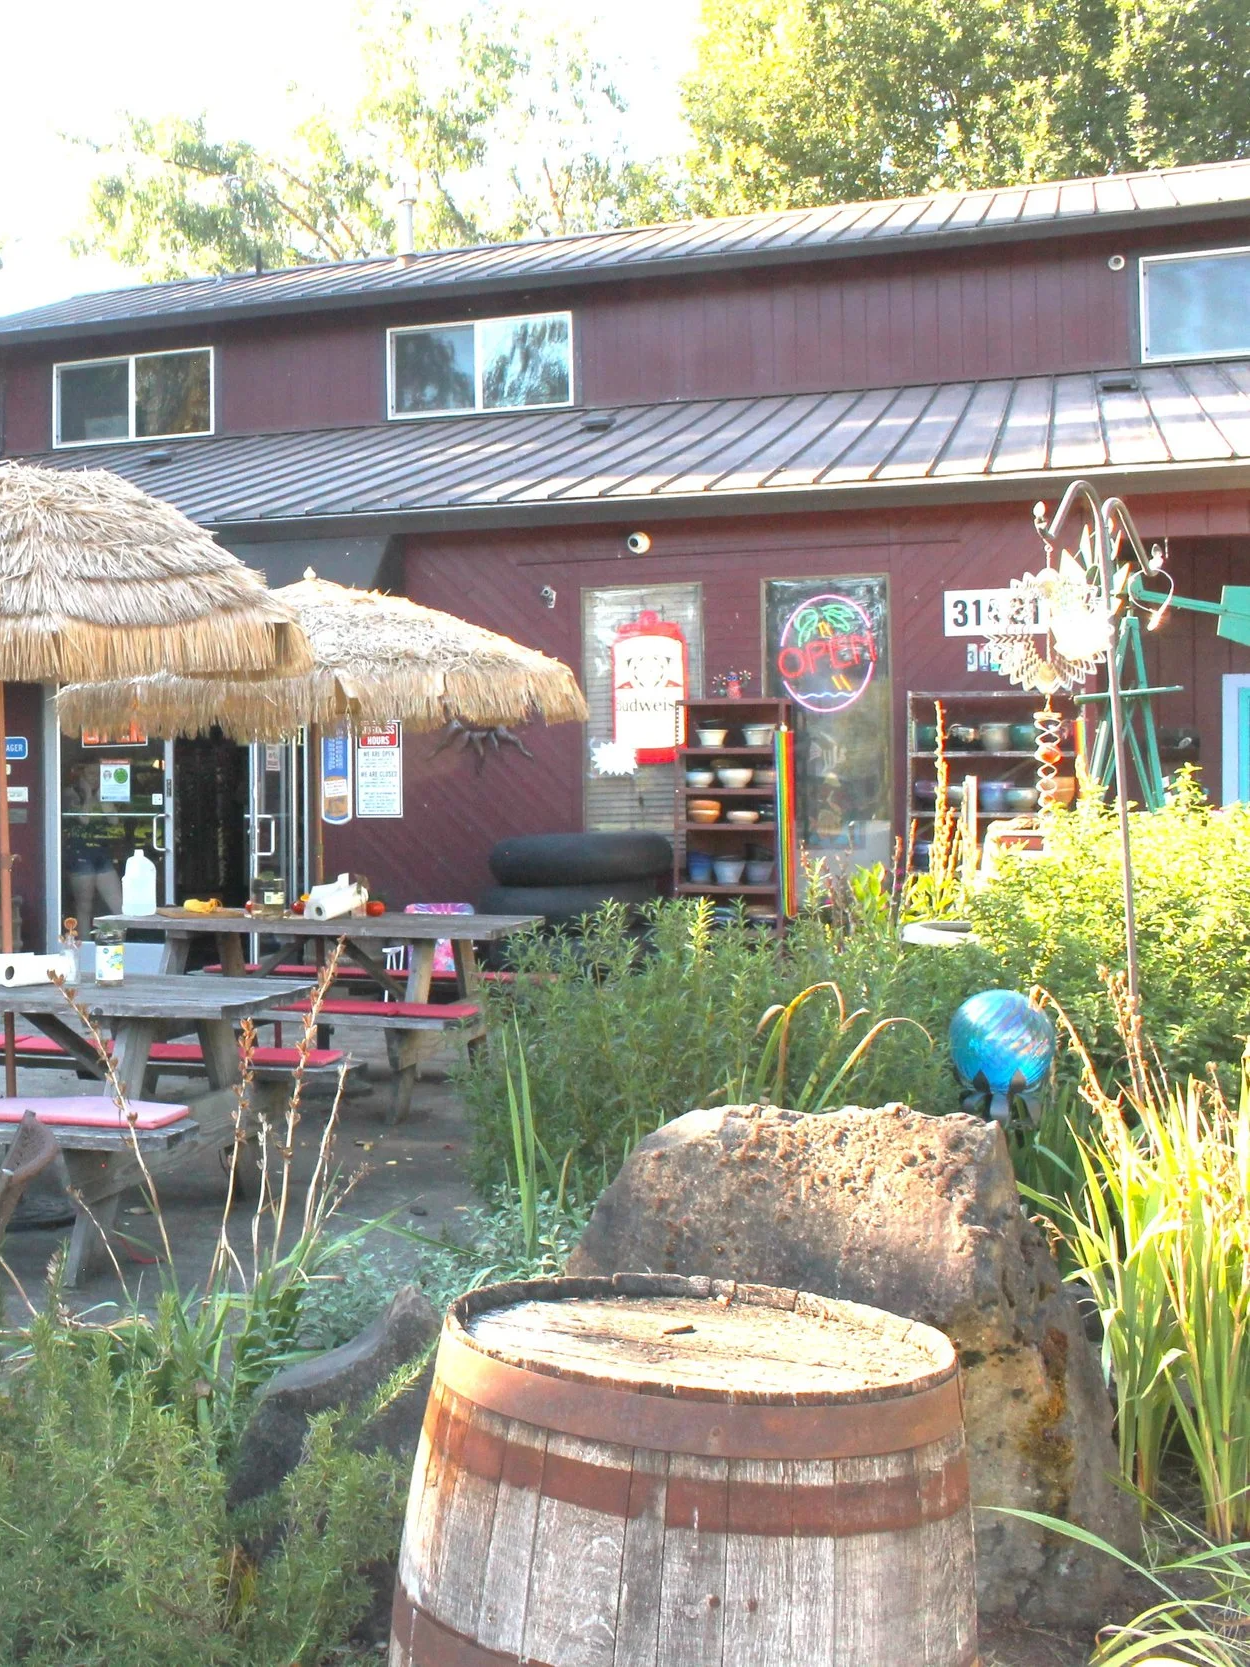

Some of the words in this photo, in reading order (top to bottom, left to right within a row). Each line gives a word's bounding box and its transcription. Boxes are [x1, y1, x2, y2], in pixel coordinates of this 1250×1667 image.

[953, 598, 1039, 627] 3121
[778, 631, 878, 679] OPEN
[367, 736, 390, 745] HOURS
